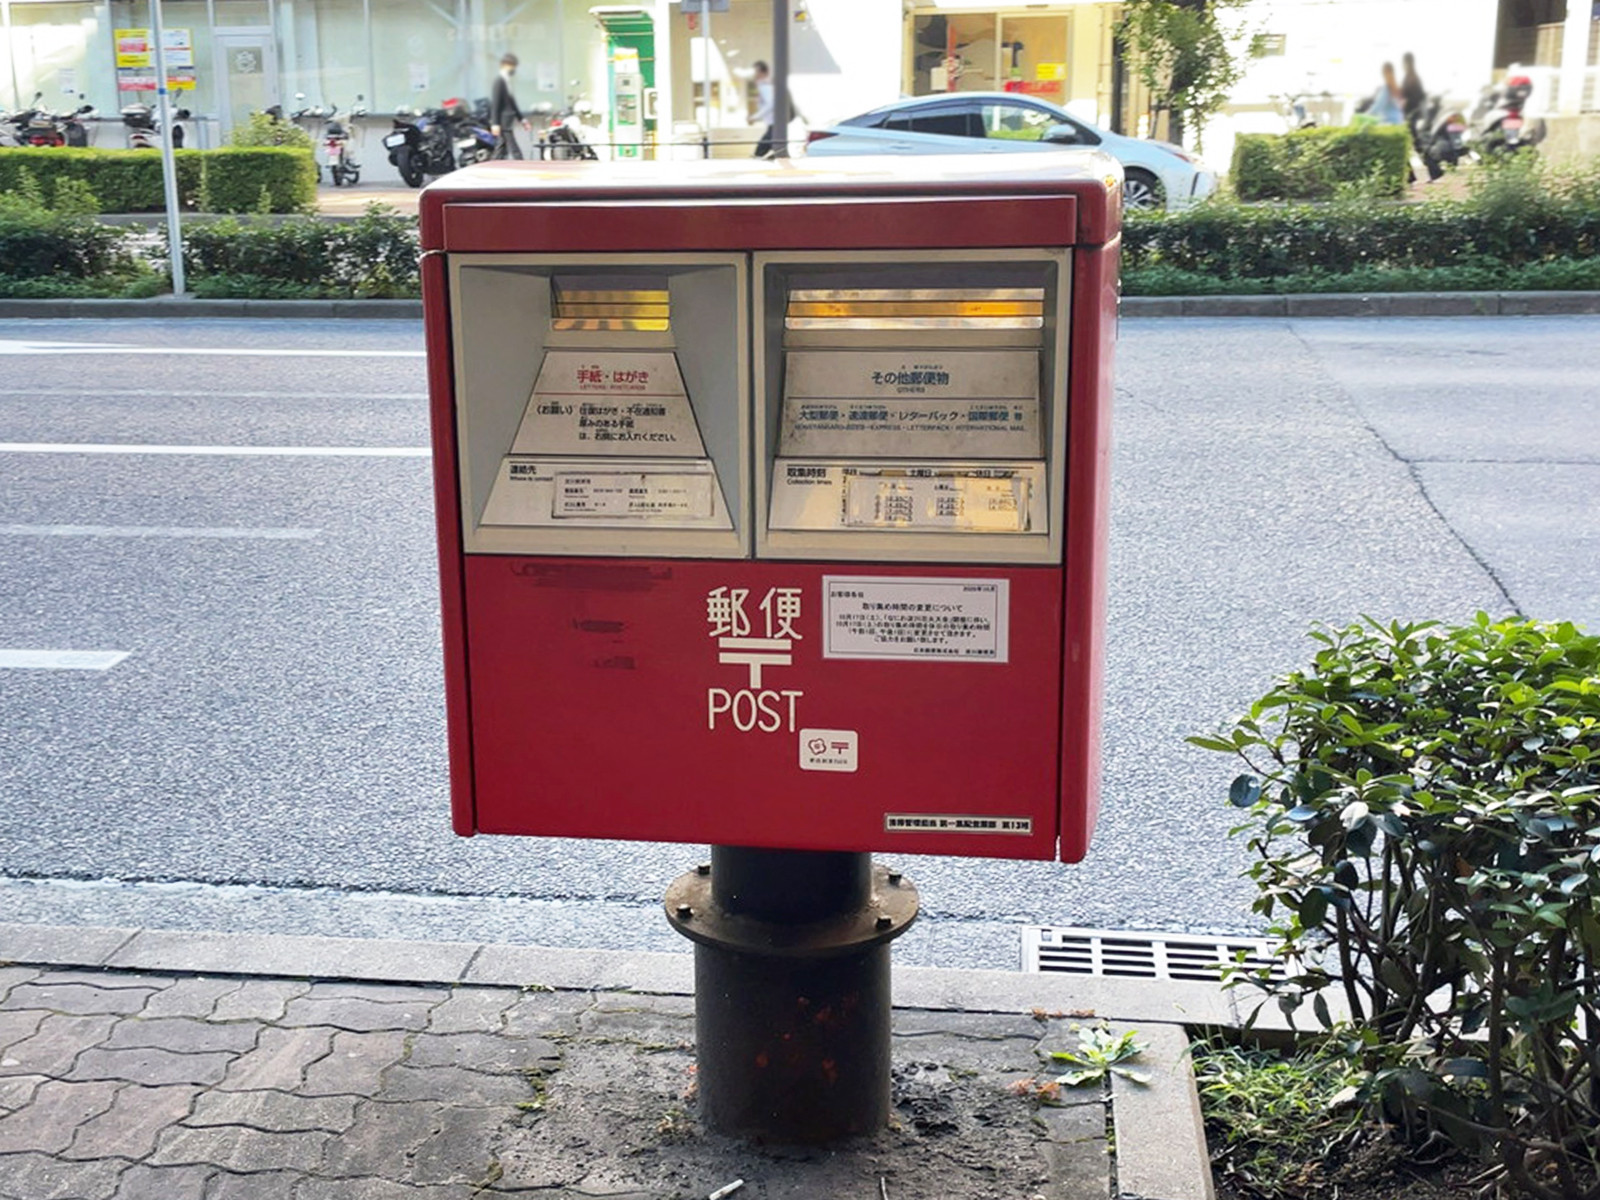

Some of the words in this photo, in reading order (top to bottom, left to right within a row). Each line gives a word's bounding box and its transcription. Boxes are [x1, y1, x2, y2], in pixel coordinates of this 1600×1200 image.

[577, 369, 649, 383] 手紙・はがき
[872, 371, 950, 385] その他郵便物
[510, 465, 537, 475] 連絡先
[706, 586, 803, 640] 郵便
[862, 603, 963, 612] 取り集め時間の変更について
[708, 688, 804, 733] POST
